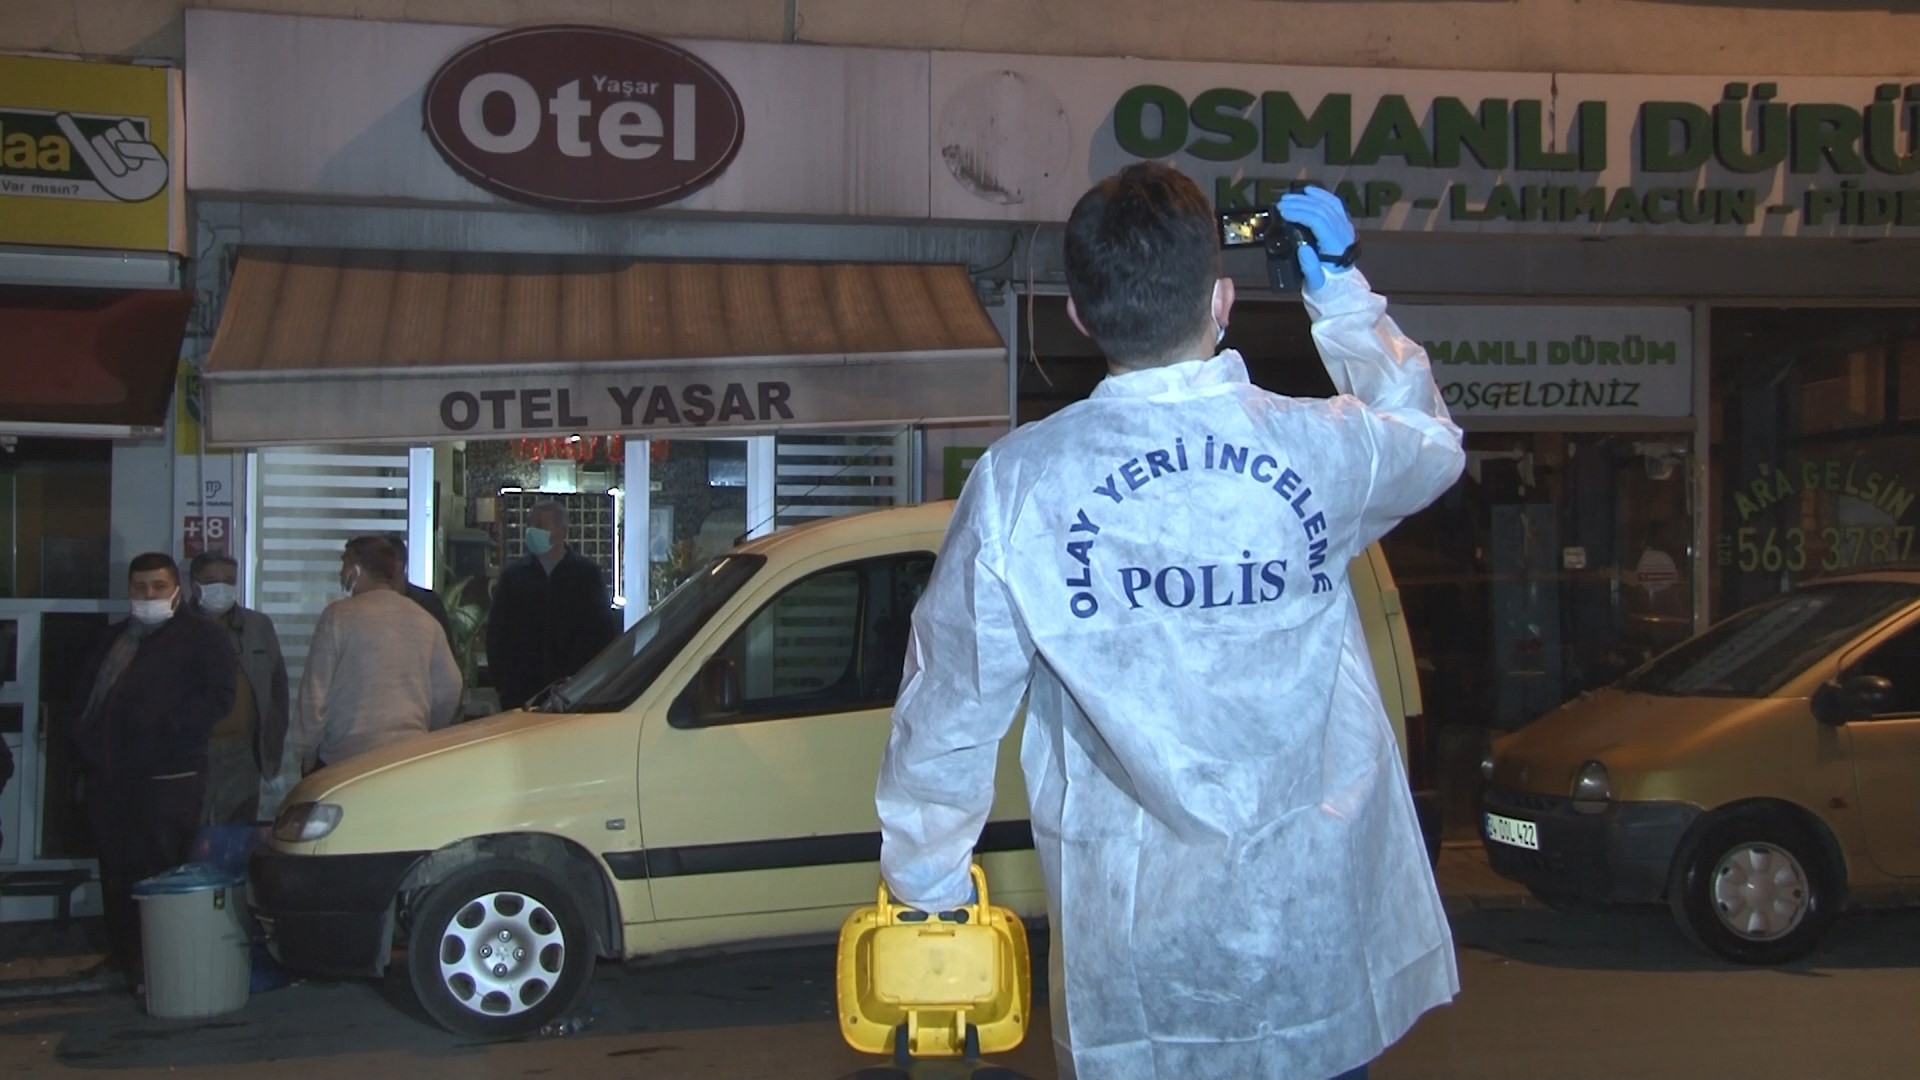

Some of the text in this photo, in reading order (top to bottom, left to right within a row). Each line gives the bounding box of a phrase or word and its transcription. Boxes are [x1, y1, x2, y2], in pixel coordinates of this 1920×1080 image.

[592, 75, 660, 97] Yaşar
[458, 72, 696, 161] Otel
[1112, 83, 1607, 173] OSMANLI
[0, 120, 71, 171] aa
[2, 179, 26, 194] Var
[1449, 184, 1756, 225] LAHMACUN
[1548, 335, 1676, 366] DÜRÜM
[439, 388, 588, 431] OTEL
[1436, 377, 1641, 411] OŞGELDİNİZ
[1066, 435, 1333, 619] OLAY YERİ İNCELEME
[1738, 527, 1806, 573] 563
[1821, 525, 1915, 572] 3787
[1117, 550, 1288, 610] POLİS
